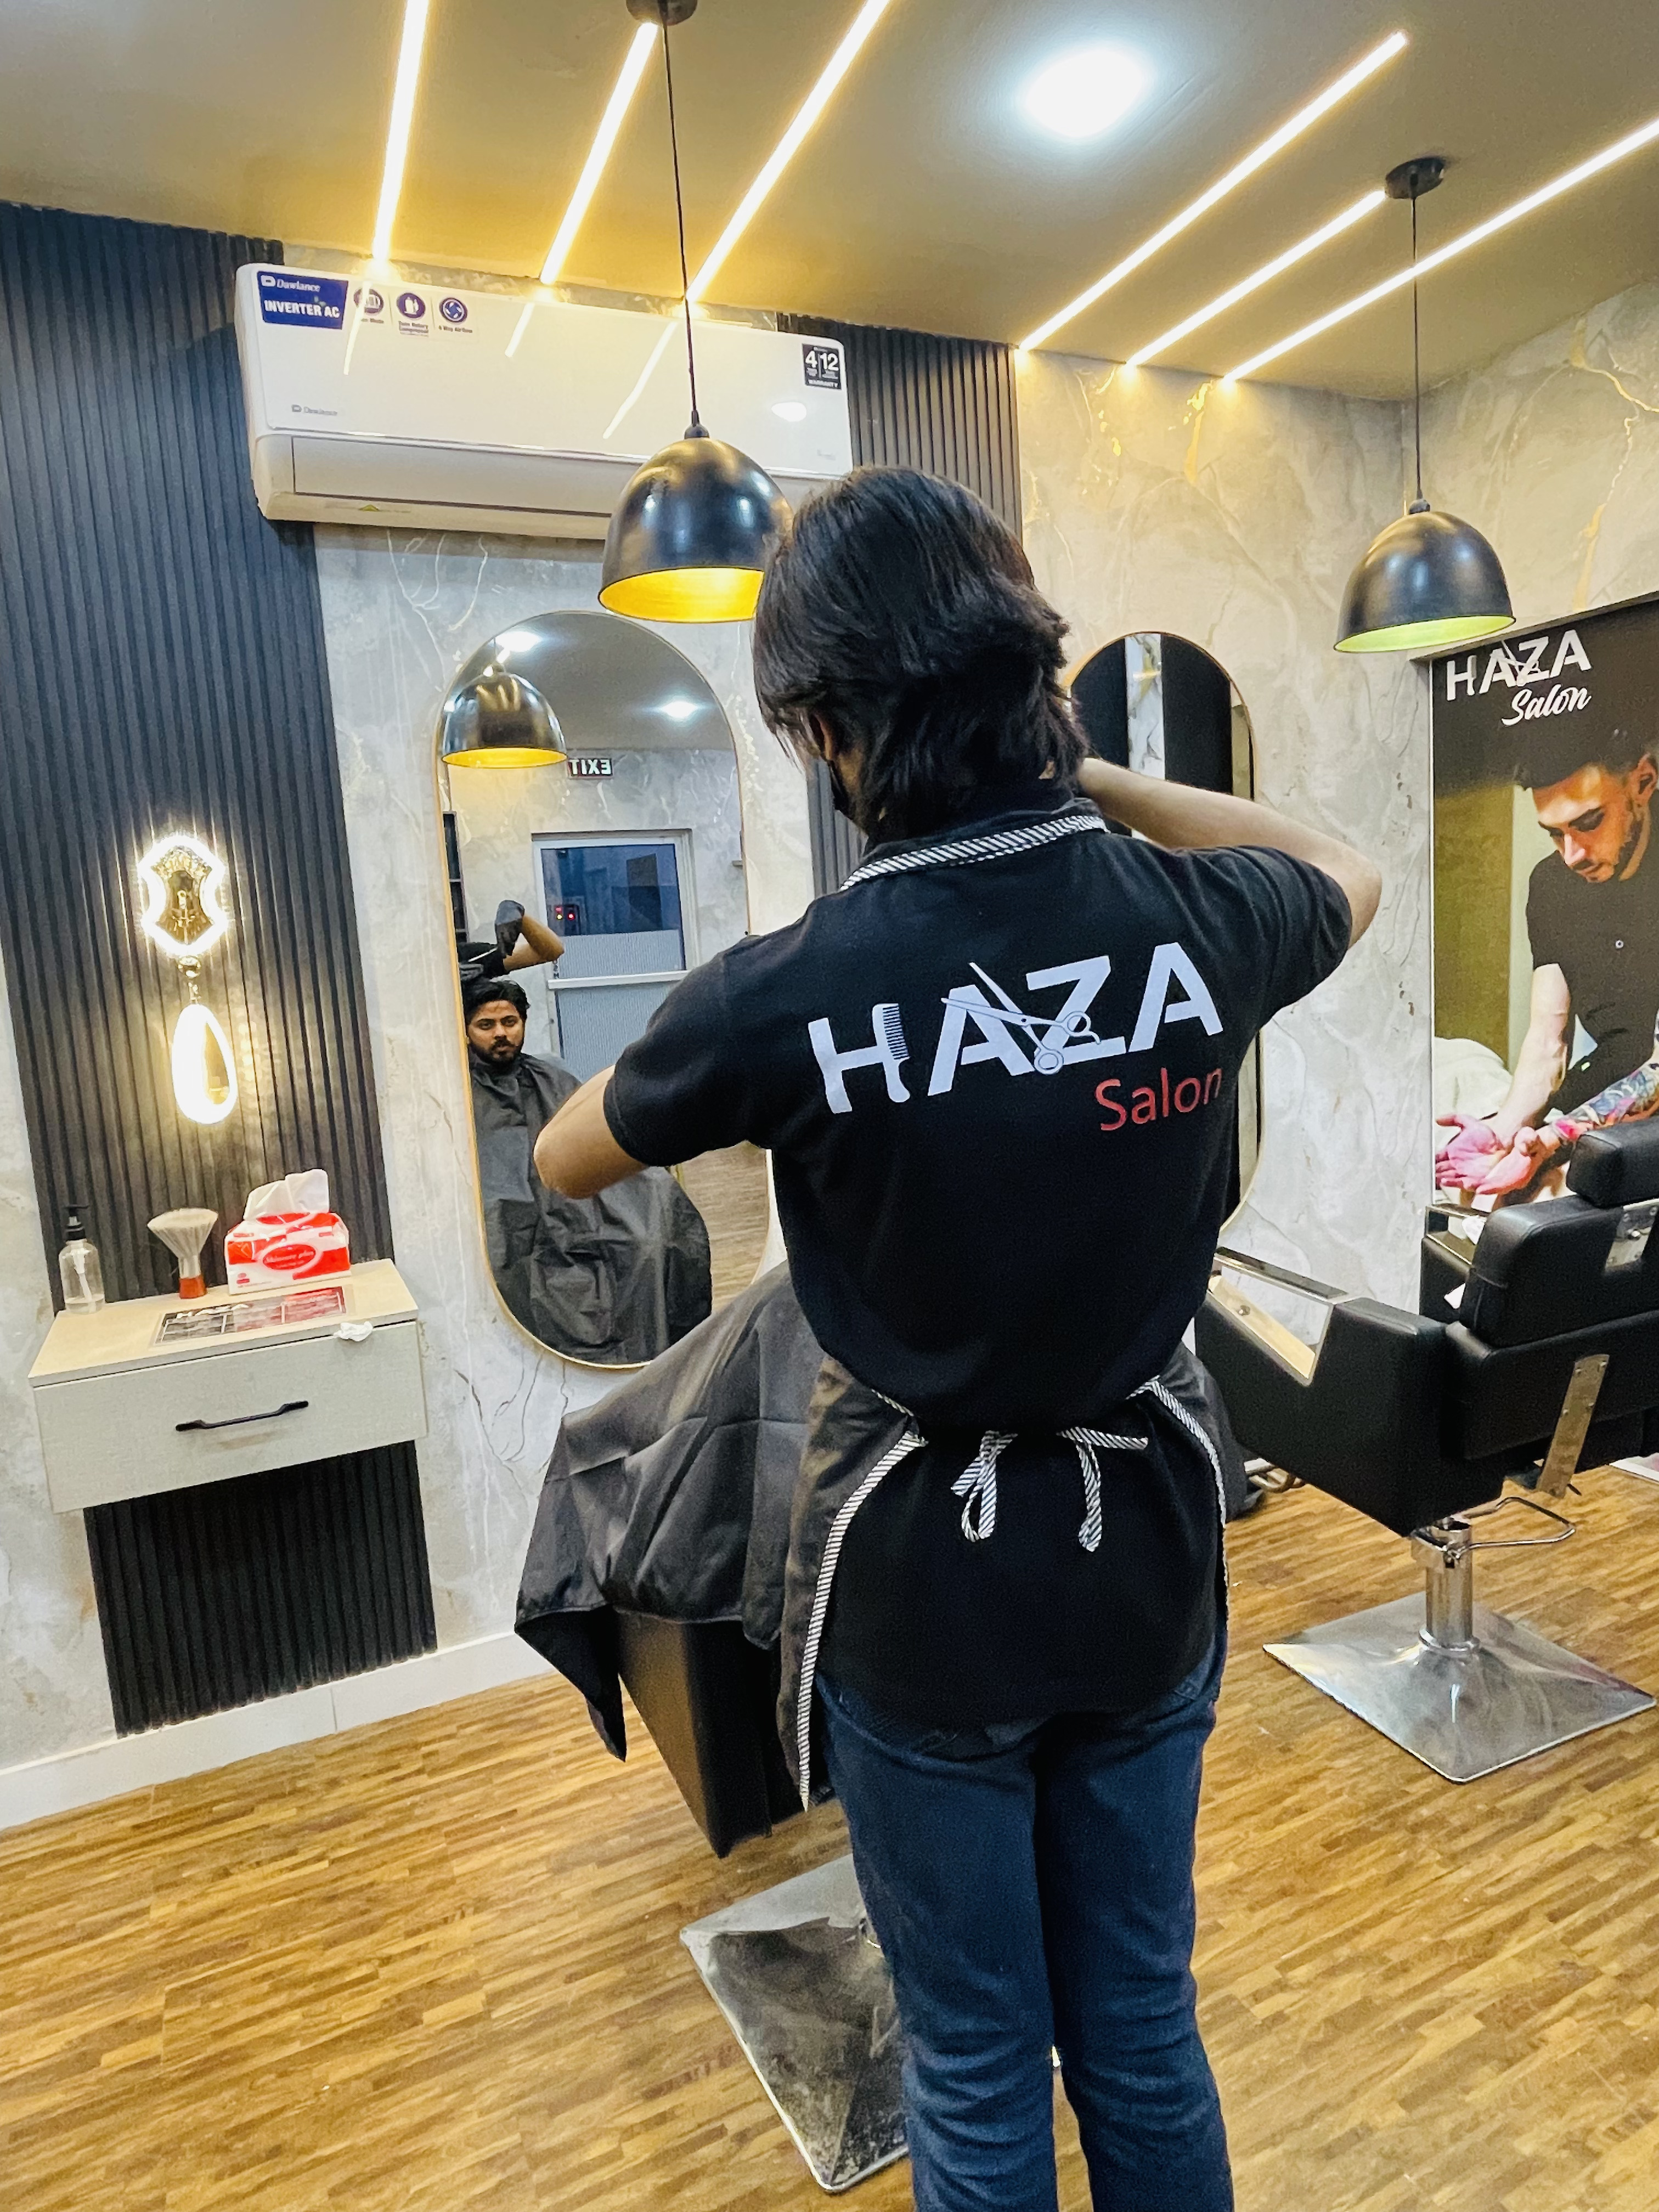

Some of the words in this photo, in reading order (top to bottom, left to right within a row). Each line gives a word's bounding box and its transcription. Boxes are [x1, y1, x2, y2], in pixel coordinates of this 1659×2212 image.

[264, 300, 322, 317] INVERTER
[324, 306, 340, 318] AC
[805, 350, 818, 368] 4
[820, 352, 839, 371] 12
[1447, 629, 1591, 701] HAZA
[1501, 684, 1592, 726] Salon
[808, 942, 1224, 1115] HAZA
[1095, 1067, 1223, 1131] Salon
